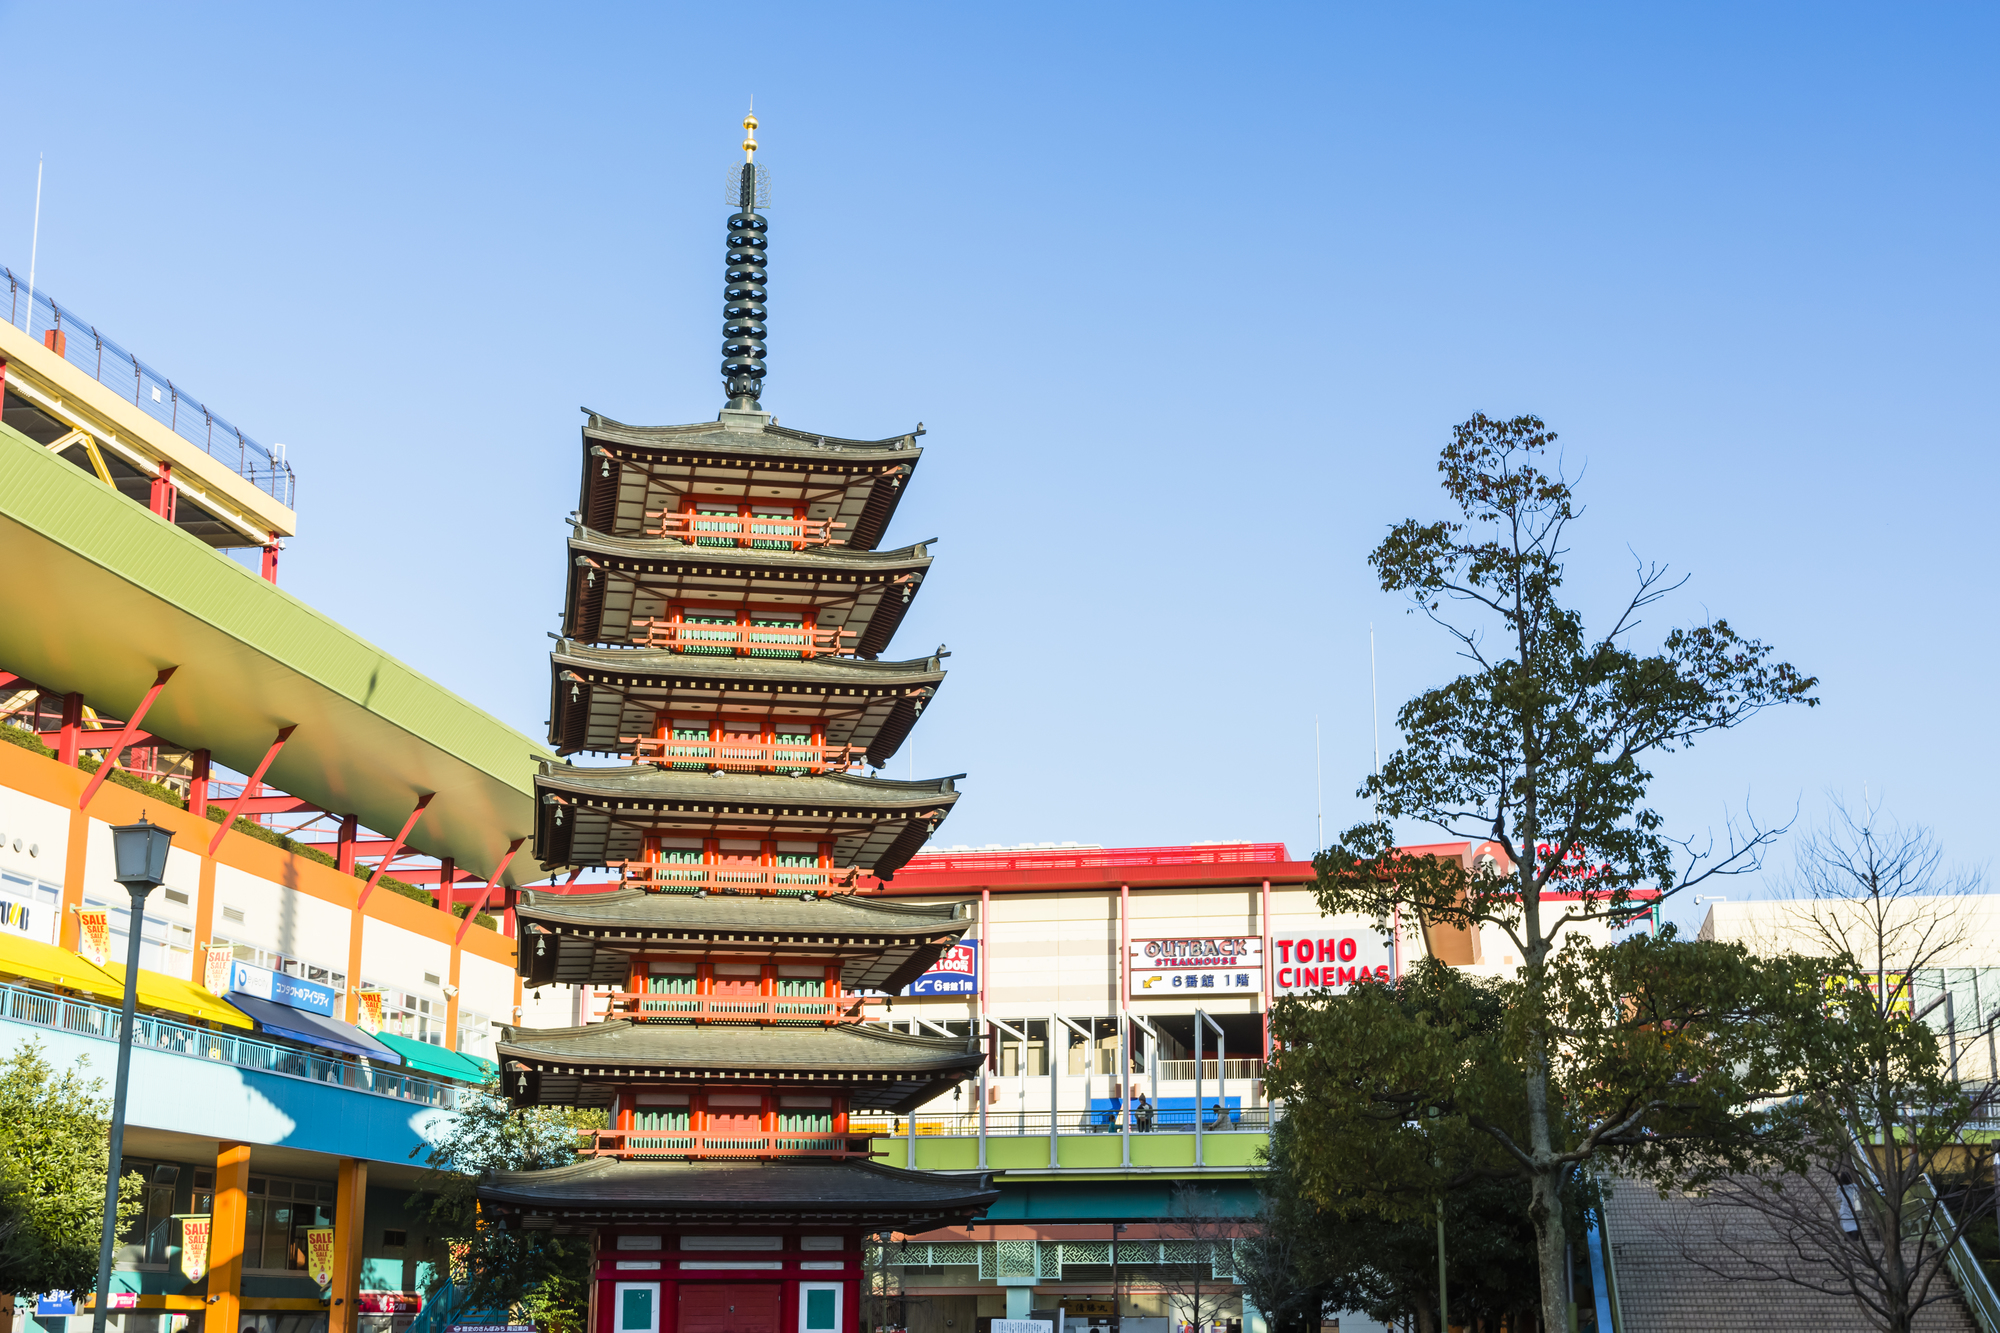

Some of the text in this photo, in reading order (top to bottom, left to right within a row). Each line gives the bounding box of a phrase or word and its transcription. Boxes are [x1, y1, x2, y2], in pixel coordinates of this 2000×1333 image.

[81, 914, 107, 925] SALE
[87, 925, 105, 934] SALE
[1144, 939, 1247, 958] OUTBACK
[1276, 937, 1357, 963] TOHO
[208, 951, 232, 962] SALE
[1154, 957, 1238, 967] STEAKHOUSE
[210, 961, 227, 970] SALE
[1172, 973, 1250, 988] 6番館 1階
[1277, 965, 1390, 988] CINEMAS
[934, 979, 973, 992] 6番館1階
[276, 982, 330, 1007] コンタクトのアイシティ
[361, 994, 381, 1003] SALE
[184, 1222, 210, 1236] SALE
[188, 1235, 206, 1244] SALE
[309, 1232, 333, 1244] SALE
[313, 1243, 330, 1252] SALE
